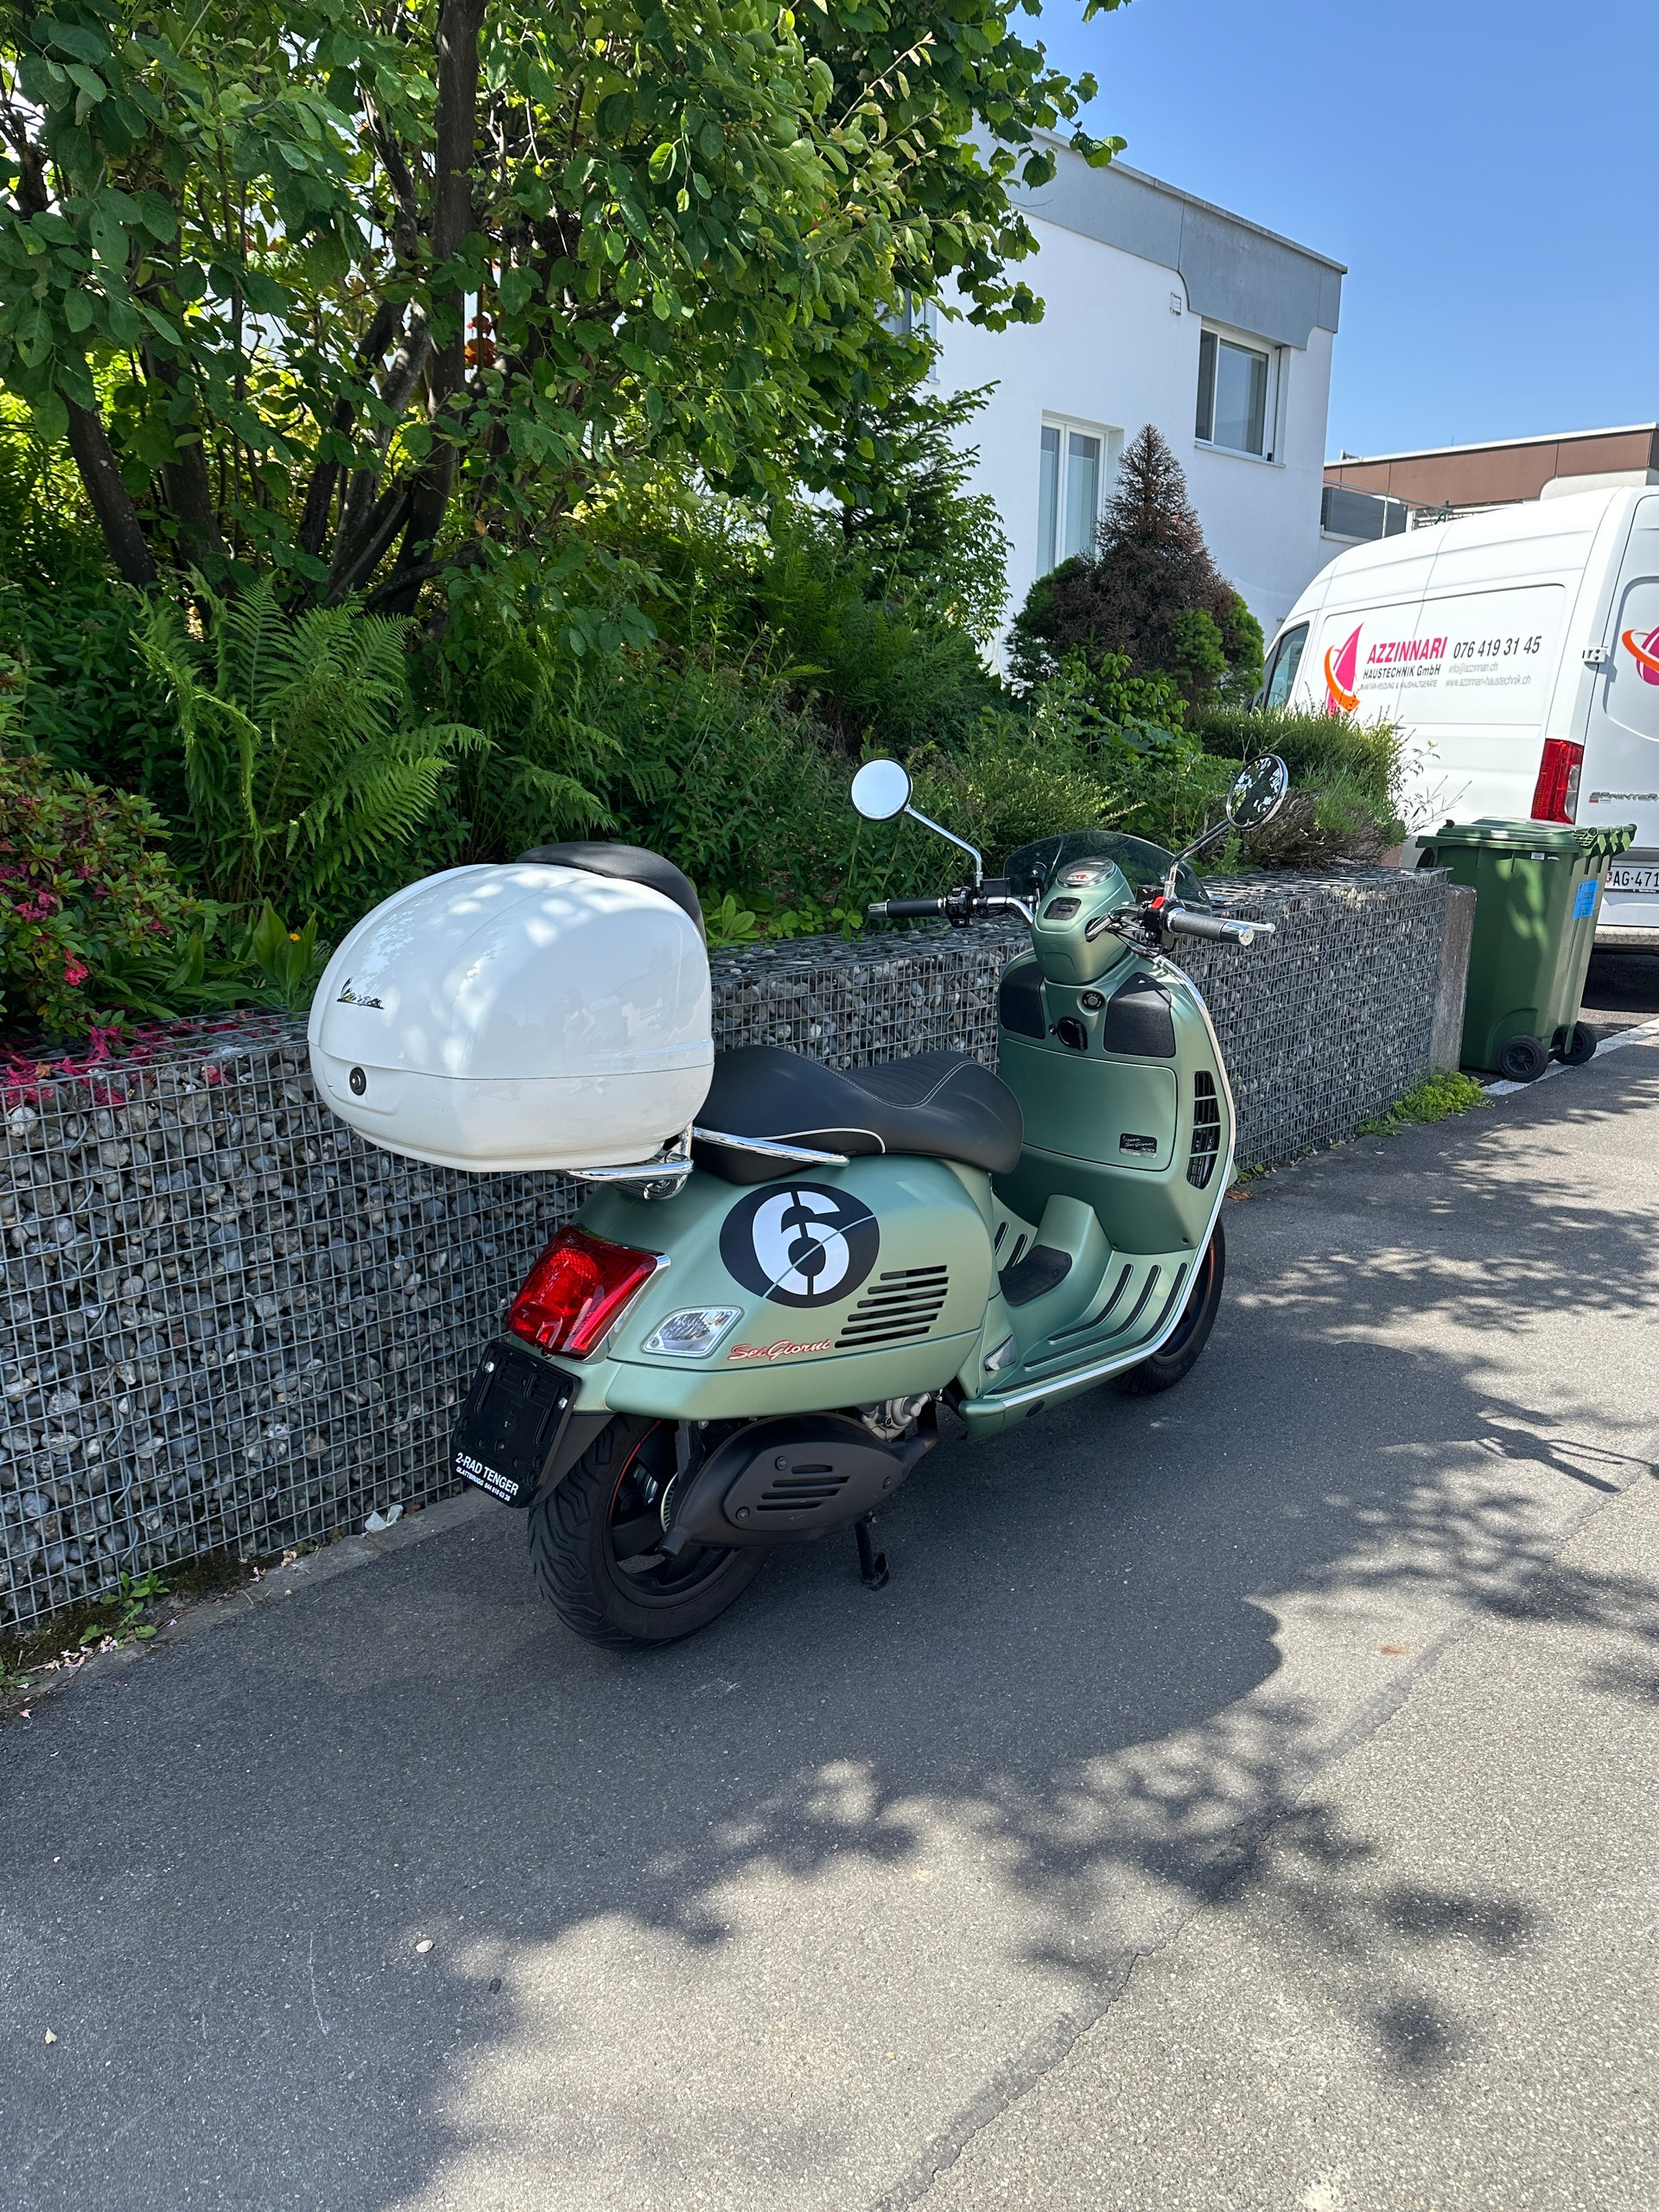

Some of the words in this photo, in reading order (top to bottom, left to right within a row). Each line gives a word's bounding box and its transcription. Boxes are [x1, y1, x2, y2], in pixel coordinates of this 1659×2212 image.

[1366, 636, 1448, 664] AZZINNARI
[1453, 641, 1475, 658] 076
[1478, 639, 1501, 657] 419
[1503, 638, 1520, 656] 31
[1523, 636, 1541, 654] 45
[1363, 665, 1415, 679] HAUSTECHNIK
[1416, 664, 1441, 677] GmbH
[752, 1191, 850, 1295] 6
[455, 1452, 482, 1474] 2-RAD
[483, 1466, 518, 1496] TENGER
